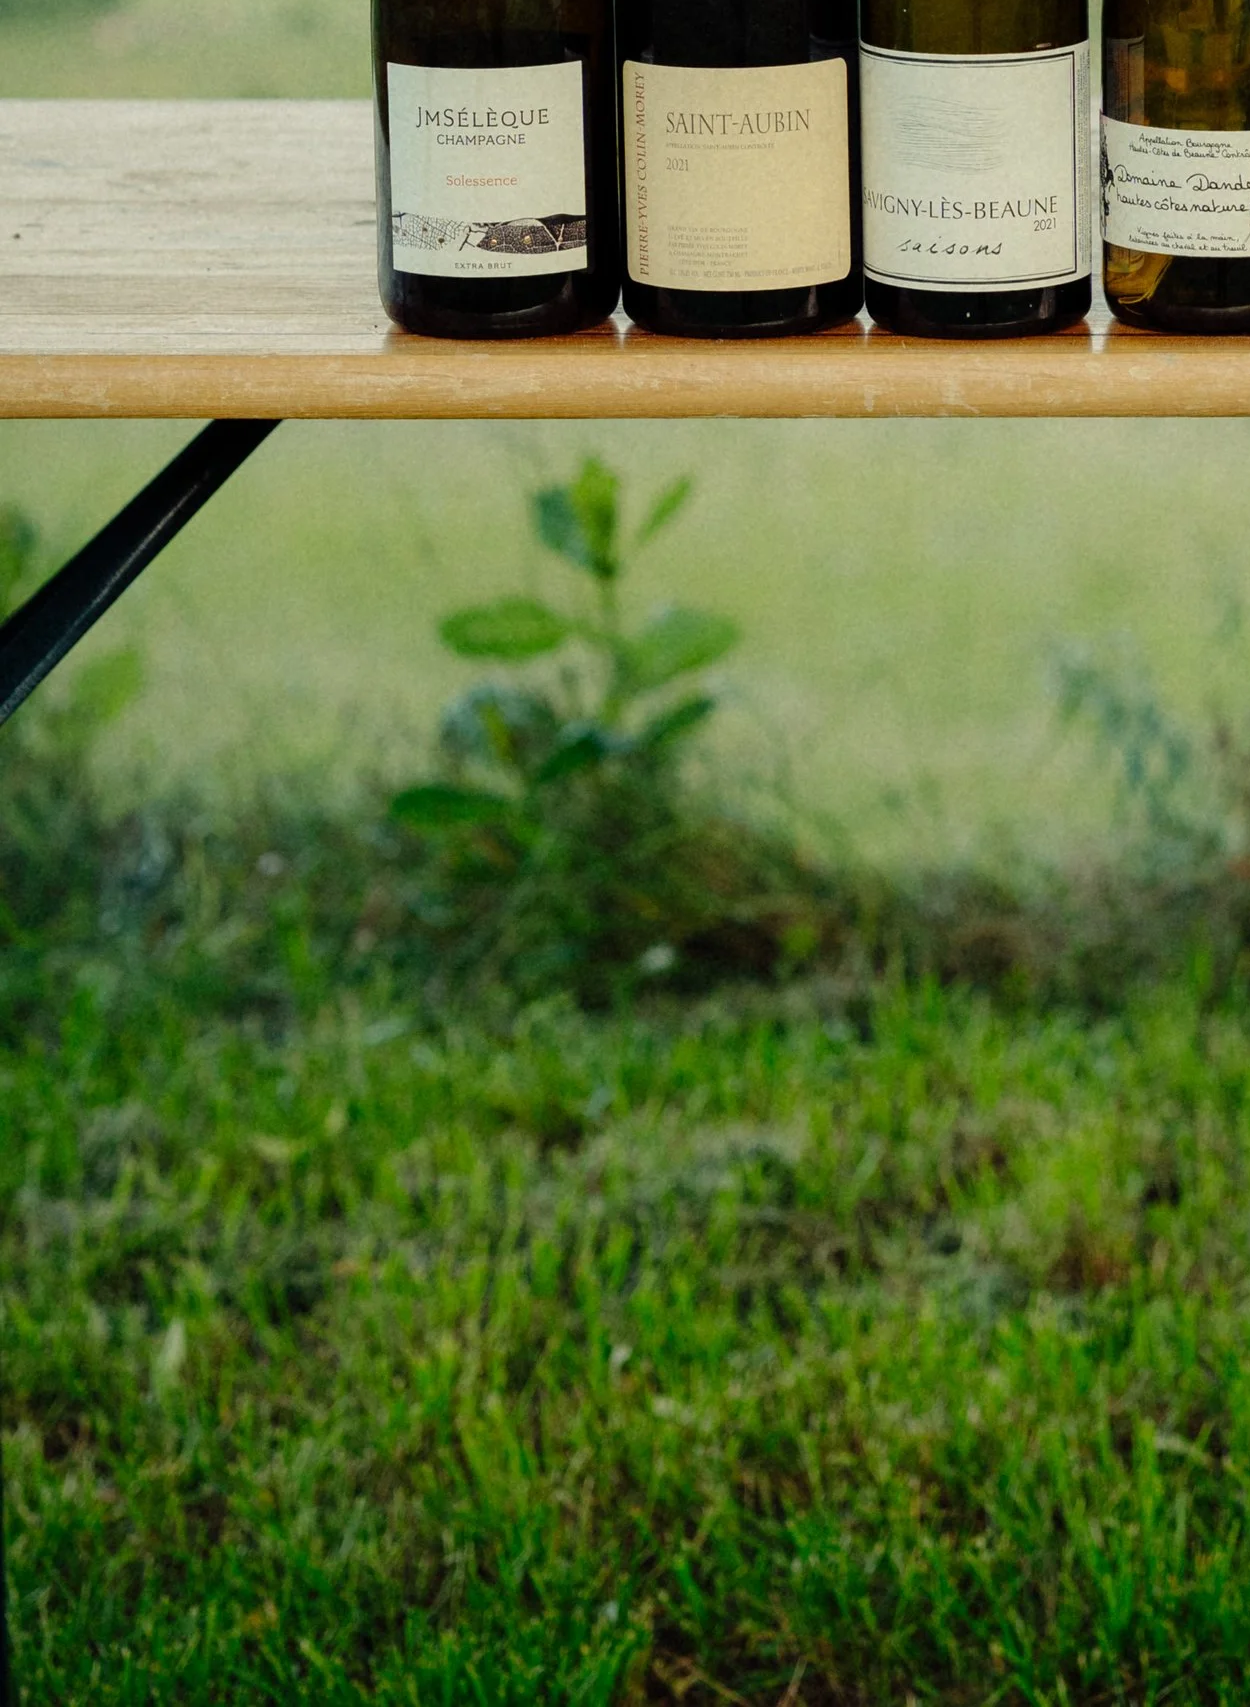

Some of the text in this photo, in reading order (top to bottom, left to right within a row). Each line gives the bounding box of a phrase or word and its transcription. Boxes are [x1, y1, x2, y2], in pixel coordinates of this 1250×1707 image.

[666, 109, 811, 135] SAINT-AUBIN
[436, 133, 526, 145] CHAMPAGNE
[1139, 133, 1232, 152] Appellation Bourgogne
[1184, 148, 1218, 159] Beaune
[666, 157, 689, 172] 2021
[446, 175, 518, 187] Solessence
[635, 72, 650, 276] PIERRE-YVES COLIN-MOREY
[1114, 164, 1182, 188] Domaine
[1116, 187, 1152, 208] hautes
[1154, 197, 1187, 213] côtes
[1190, 199, 1247, 213] nature
[1034, 218, 1057, 232] 2021
[1137, 226, 1159, 239] Vignes
[1163, 232, 1184, 241] faites
[898, 236, 1002, 255] saisons
[1172, 243, 1196, 251] cheval
